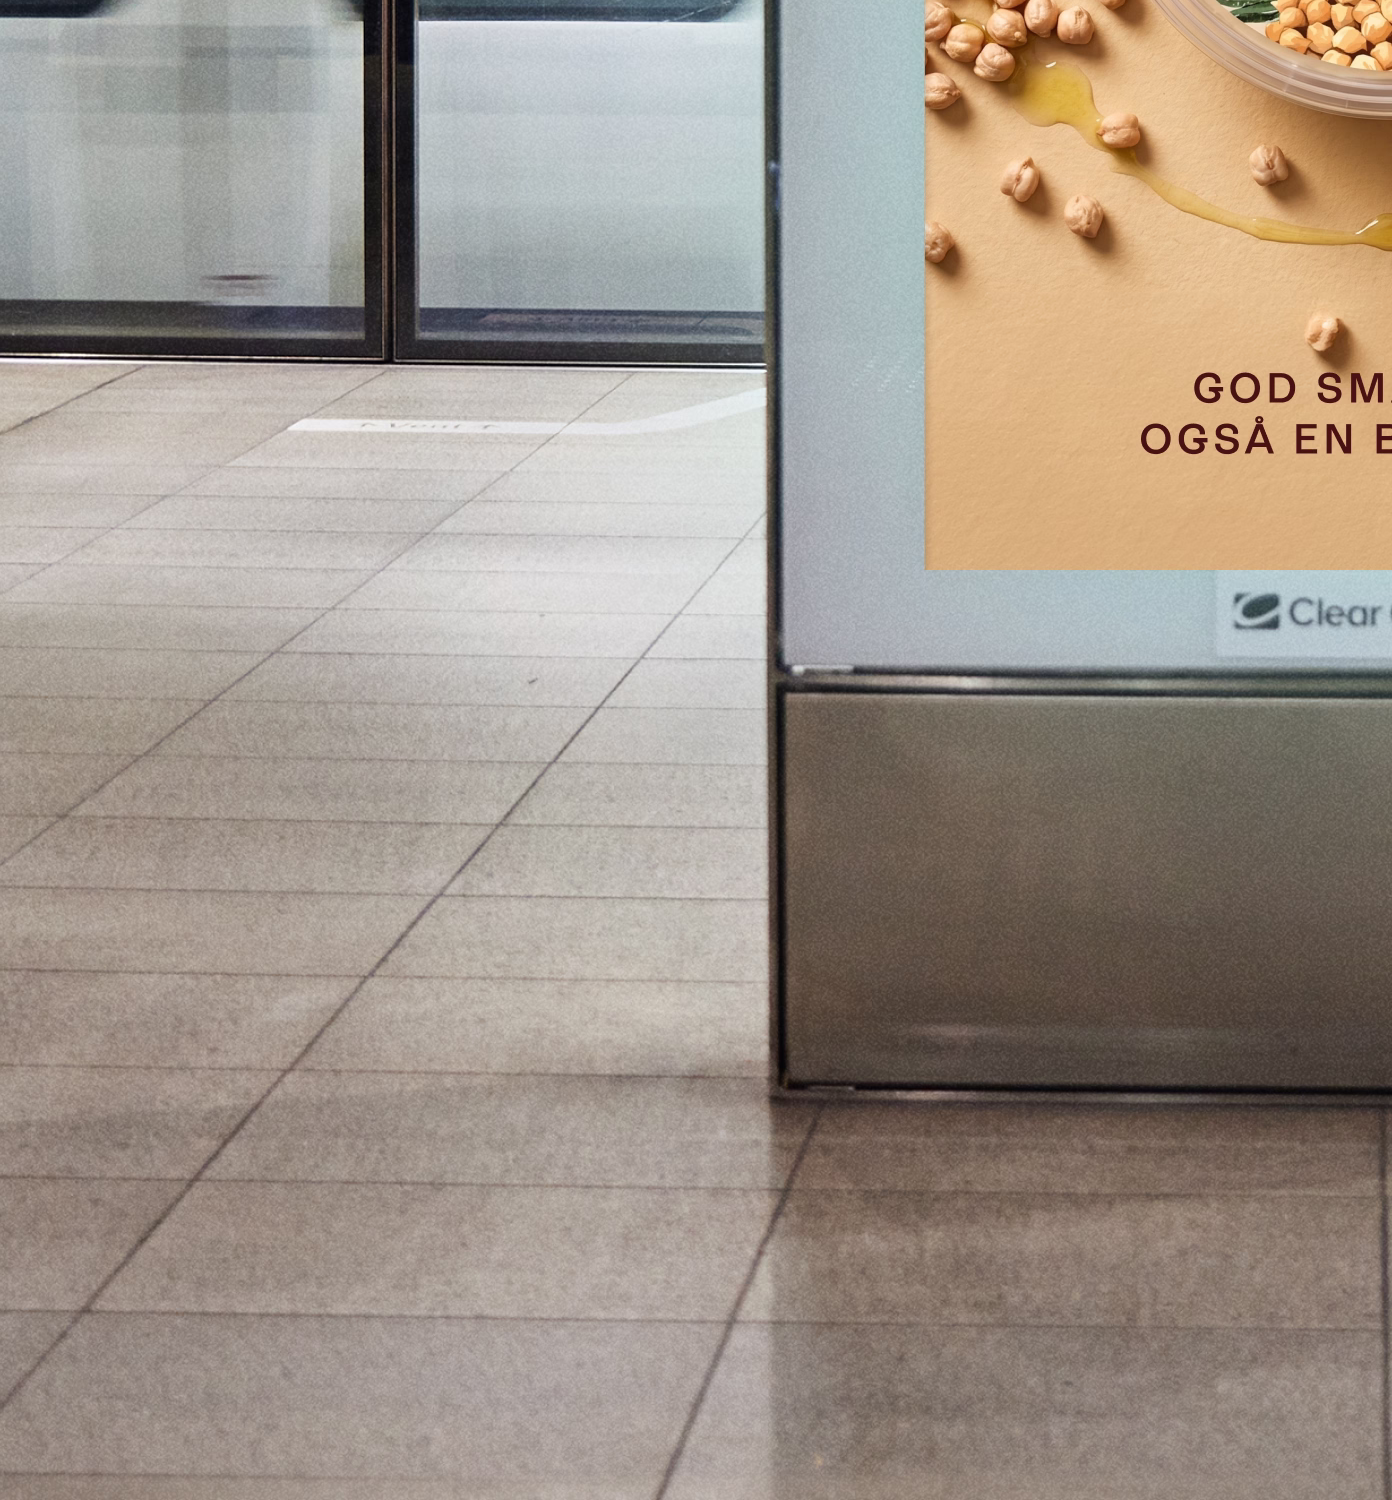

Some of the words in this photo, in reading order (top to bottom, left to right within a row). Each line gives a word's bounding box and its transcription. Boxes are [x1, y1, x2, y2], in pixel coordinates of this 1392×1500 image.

[1194, 372, 1297, 404] GOD
[1140, 416, 1275, 456] OGSÅ
[1296, 424, 1353, 455] EN
[1289, 597, 1382, 628] Clear
